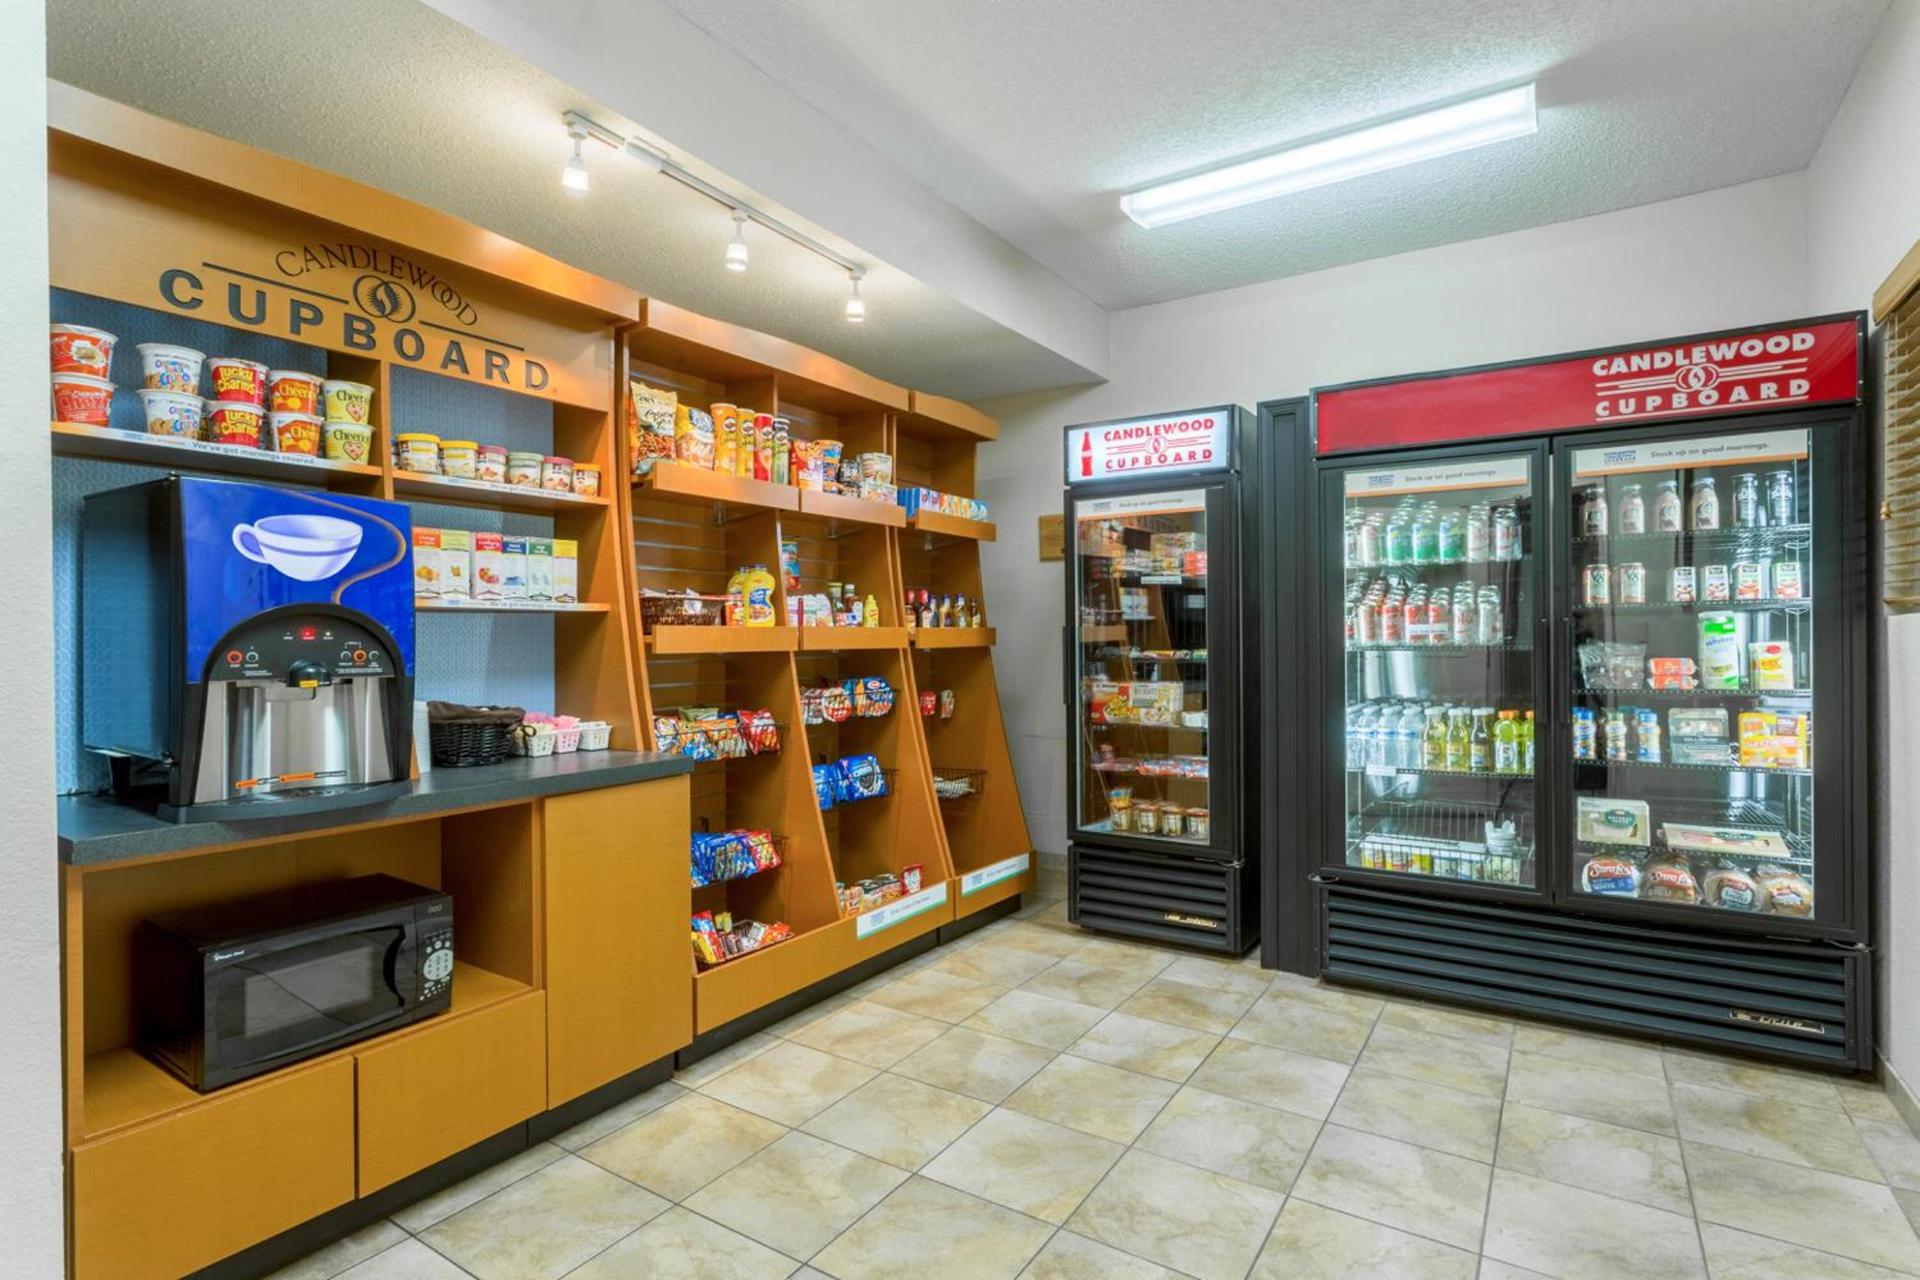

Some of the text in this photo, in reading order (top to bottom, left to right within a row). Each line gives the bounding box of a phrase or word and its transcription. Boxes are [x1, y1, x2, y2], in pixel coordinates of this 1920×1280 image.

[276, 243, 478, 326] CANDLEWOOD
[159, 268, 549, 390] CUPBOARD
[1592, 332, 1815, 376] CANDLEWOOD
[1595, 378, 1810, 417] CUPBOARD
[1104, 418, 1214, 442] CANDLEWOOD
[1105, 449, 1213, 470] CUPBOARD
